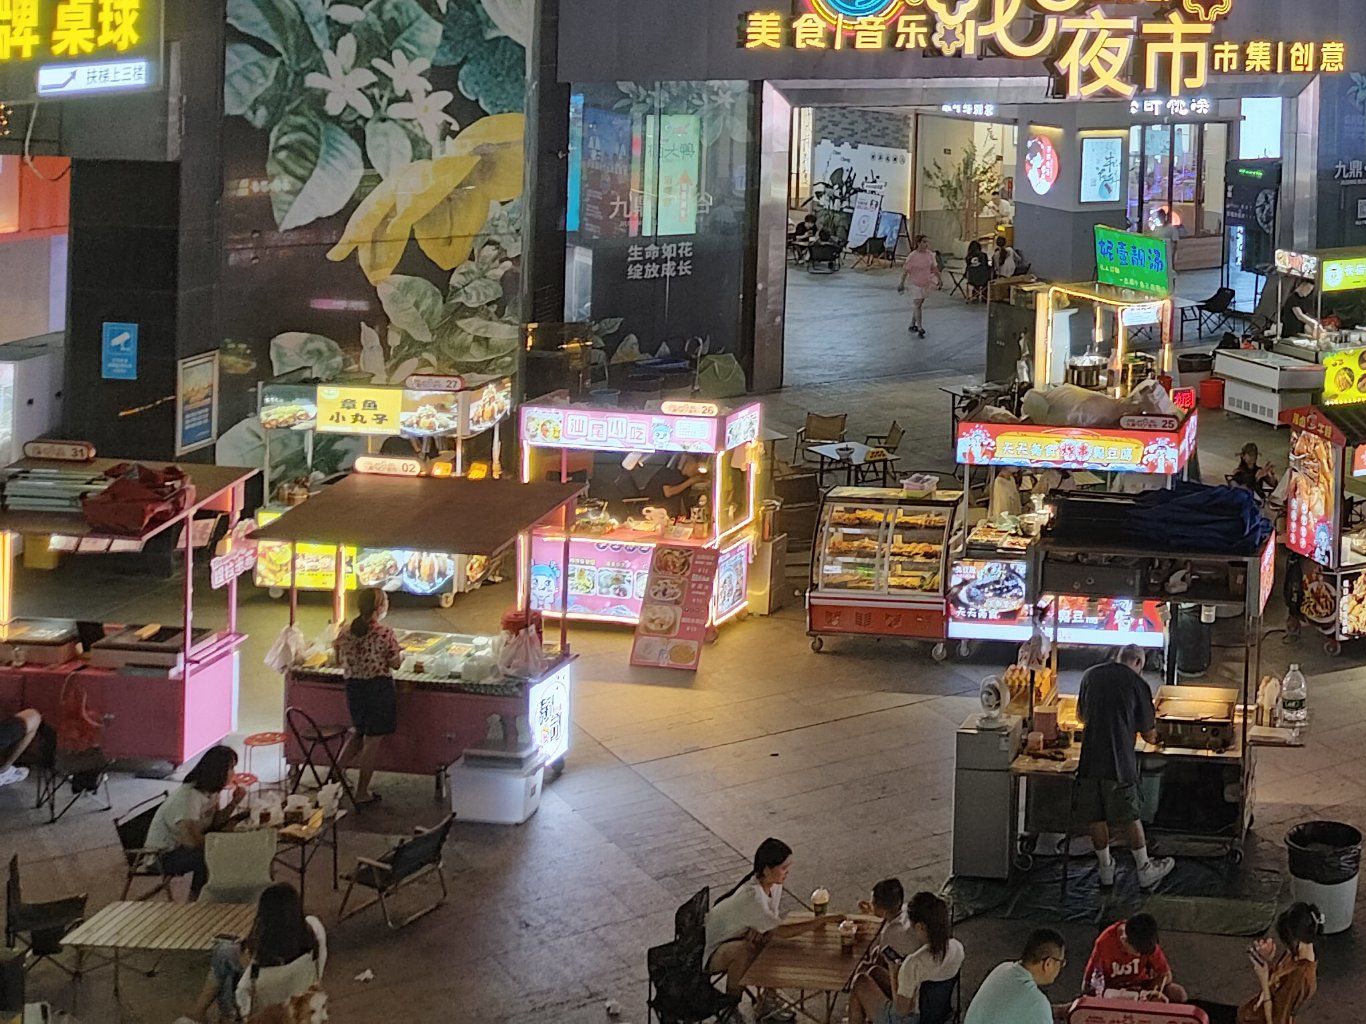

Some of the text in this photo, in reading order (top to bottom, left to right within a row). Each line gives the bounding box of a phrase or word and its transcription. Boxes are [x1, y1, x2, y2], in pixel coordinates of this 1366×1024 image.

[1058, 11, 1214, 98] 夜市
[628, 242, 694, 263] 生命如花
[627, 260, 693, 281] 绽放成长
[446, 379, 459, 389] 27
[340, 398, 379, 411] 章鱼
[701, 405, 715, 415] 26
[329, 413, 389, 426] 小丸子
[1162, 419, 1175, 429] 25
[71, 446, 85, 458] 31
[401, 462, 416, 474] 02
